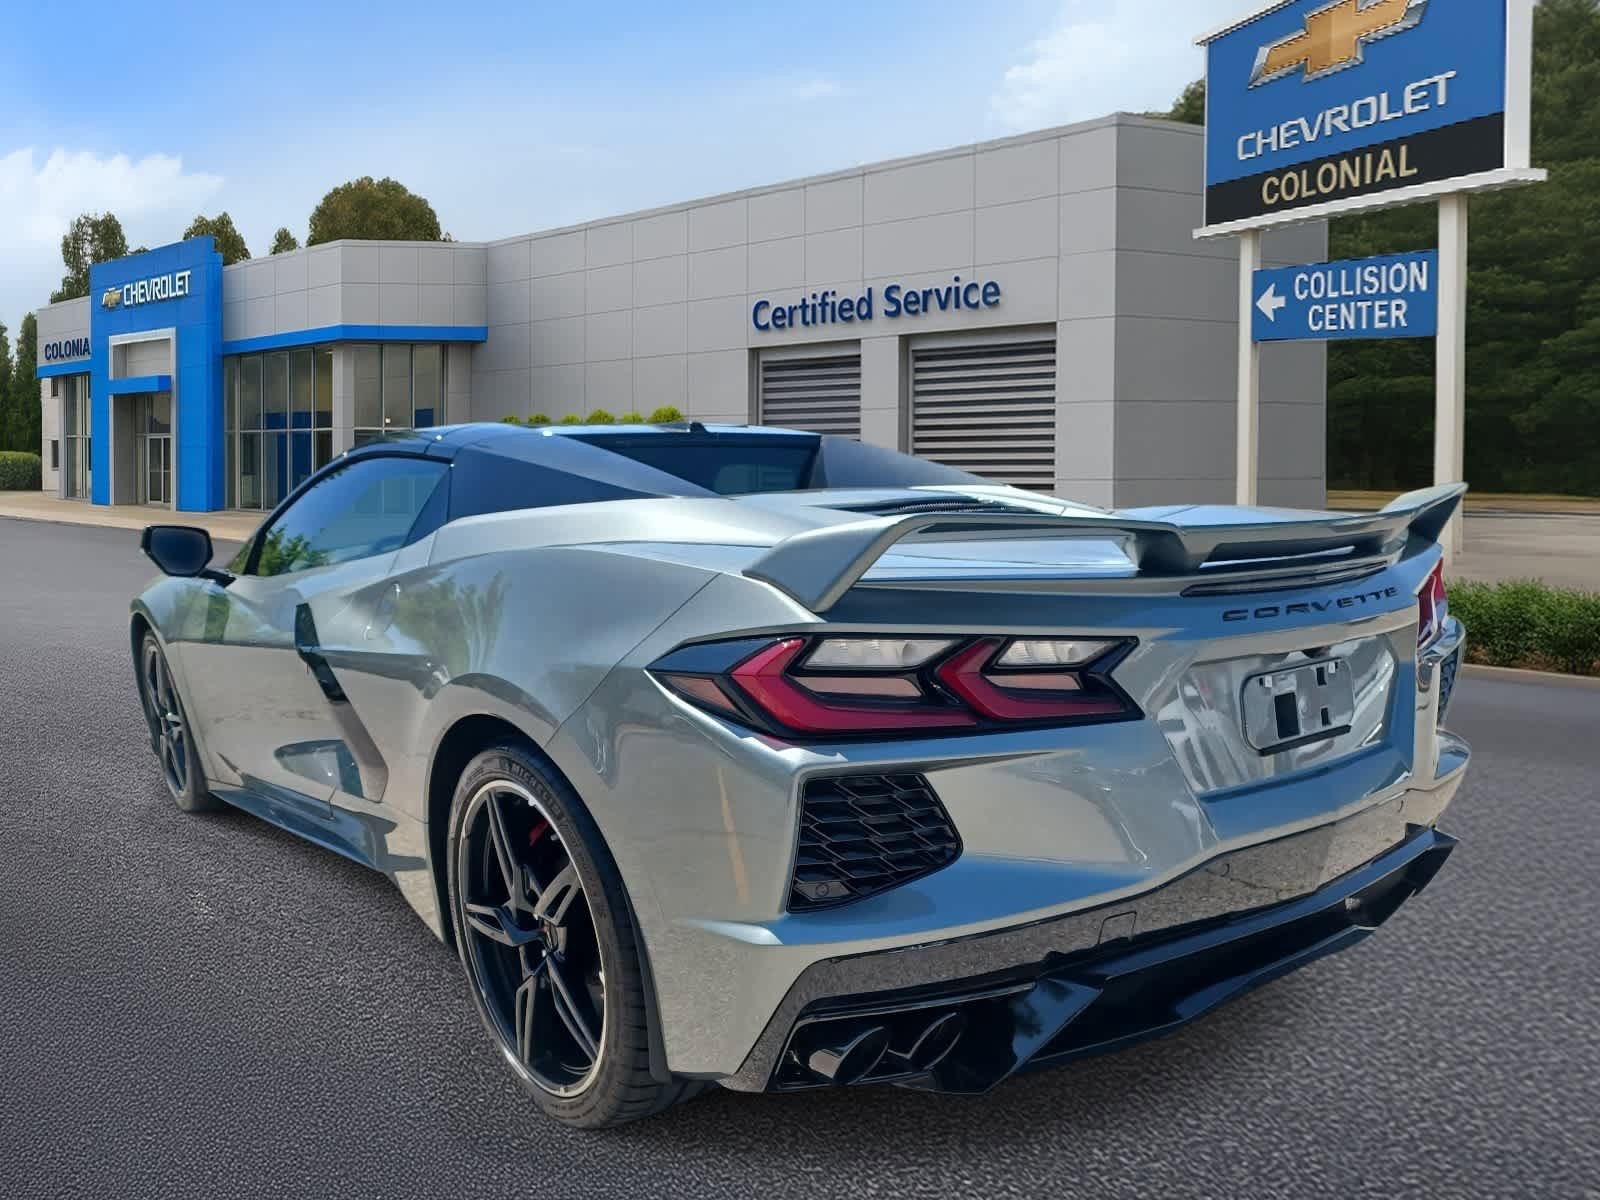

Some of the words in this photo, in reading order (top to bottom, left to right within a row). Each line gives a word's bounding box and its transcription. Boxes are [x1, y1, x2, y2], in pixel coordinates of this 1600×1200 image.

[1237, 70, 1457, 160] CHEVROLET
[1262, 145, 1418, 205] COLONIAL
[123, 270, 191, 306] CHEVROLET
[1294, 261, 1429, 300] COLLISION
[752, 287, 873, 331] Certified
[884, 275, 1001, 318] Service
[1308, 299, 1408, 331] CENTER
[1222, 587, 1399, 621] CORVETTE
